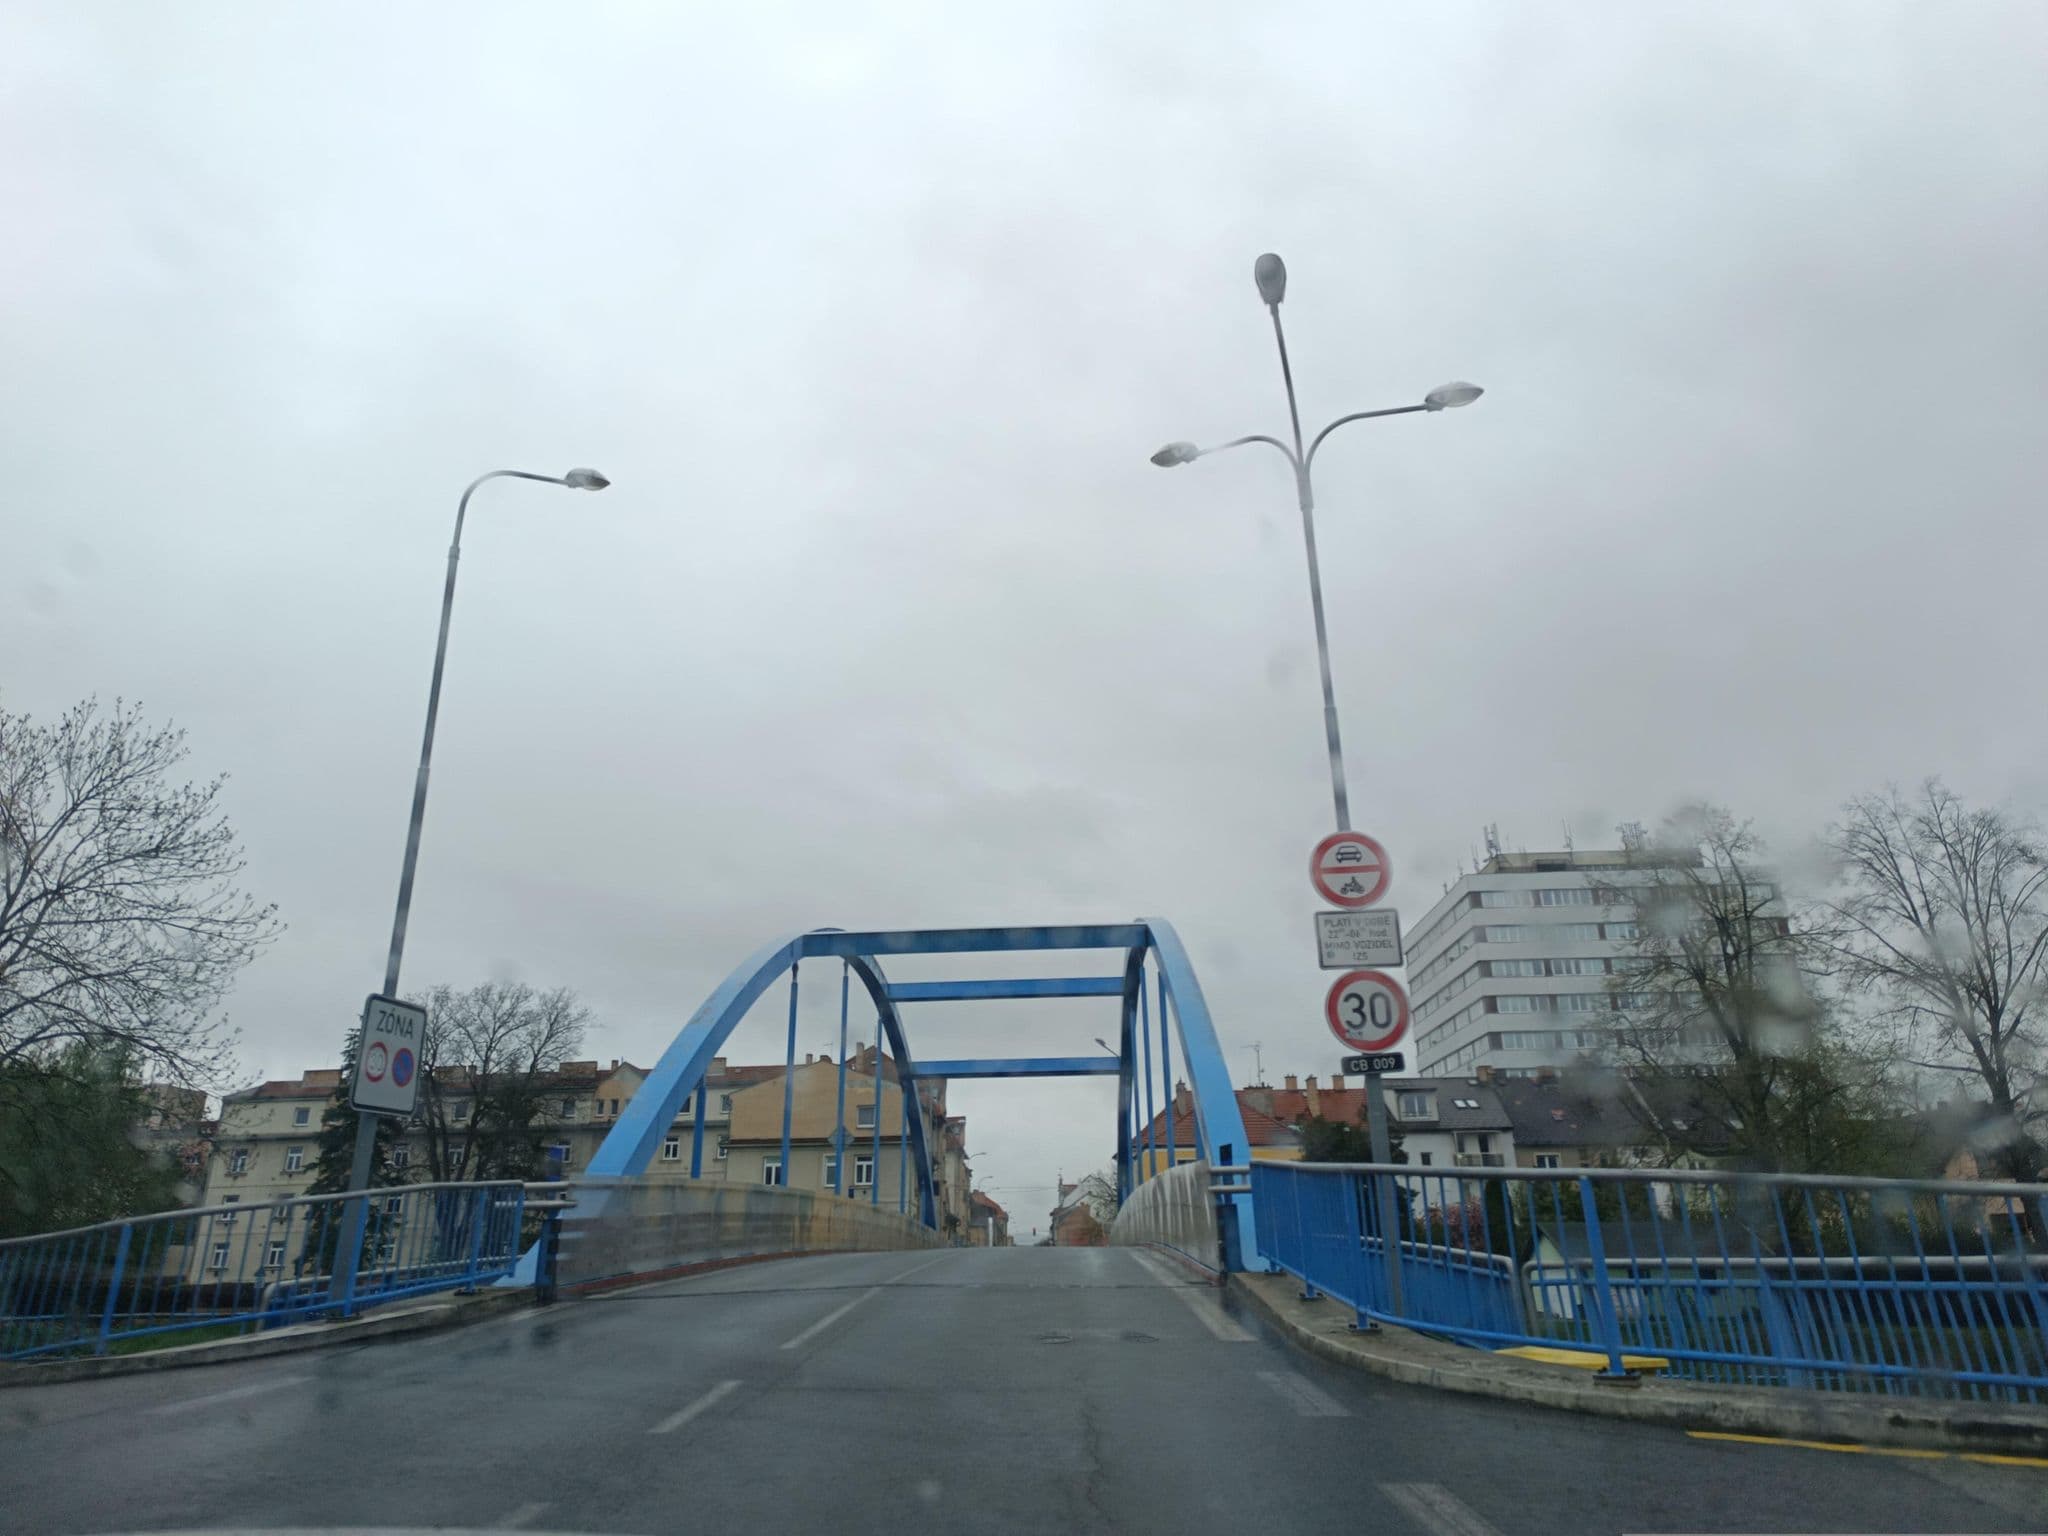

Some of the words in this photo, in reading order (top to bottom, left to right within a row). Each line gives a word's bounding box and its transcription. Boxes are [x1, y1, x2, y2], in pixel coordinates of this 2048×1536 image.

[1324, 940, 1351, 950] MIMO
[1352, 939, 1395, 949] VOZIDEL
[1343, 991, 1393, 1030] 30
[376, 1007, 413, 1039] ZÓNA
[1351, 1059, 1369, 1072] CB
[1372, 1057, 1396, 1070] 009
